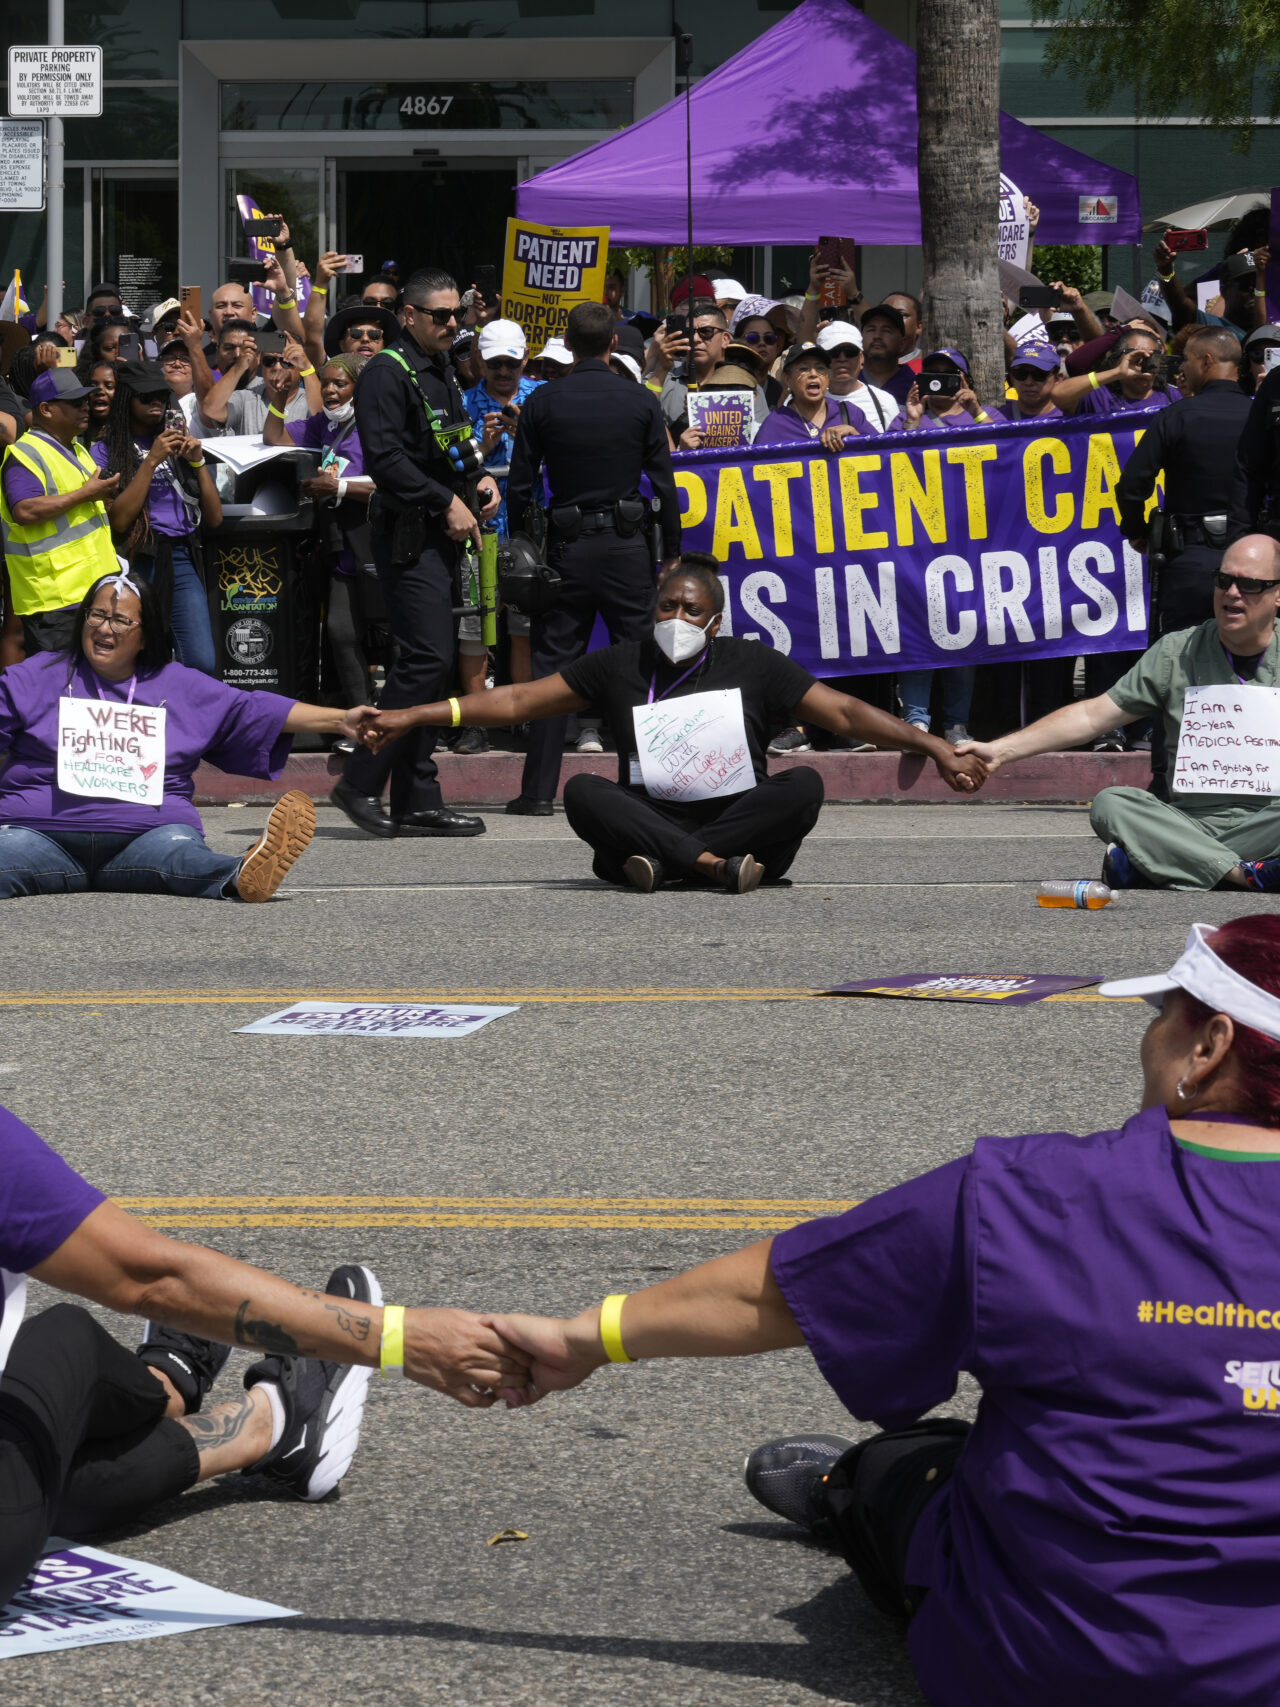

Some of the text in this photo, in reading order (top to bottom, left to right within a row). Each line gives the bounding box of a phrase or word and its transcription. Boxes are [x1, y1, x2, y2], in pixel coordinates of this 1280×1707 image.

[14, 51, 96, 62] PRIVATE PROPERTY
[40, 64, 71, 72] PARKING
[19, 73, 92, 81] BY PERMISSION ONLY
[400, 96, 454, 115] 4867
[517, 234, 596, 264] PATIENT
[527, 262, 580, 289] NEED
[541, 293, 562, 305] NOT
[505, 299, 569, 327] CORPOR
[704, 411, 742, 425] UNITED
[706, 425, 741, 436] AGAINST
[704, 437, 739, 447] KAISER'S
[673, 443, 1000, 562] PATIENT
[814, 561, 901, 660] IN
[925, 540, 1147, 651] CRISI
[1184, 700, 1198, 715] I
[1181, 733, 1242, 748] MEDICAL
[95, 752, 126, 766] FOR
[1176, 756, 1191, 772] I
[63, 760, 134, 778] HEALTHCARE
[73, 773, 150, 798] WORKERS
[296, 1013, 470, 1021] PATIENTS
[356, 1008, 431, 1016] OUR
